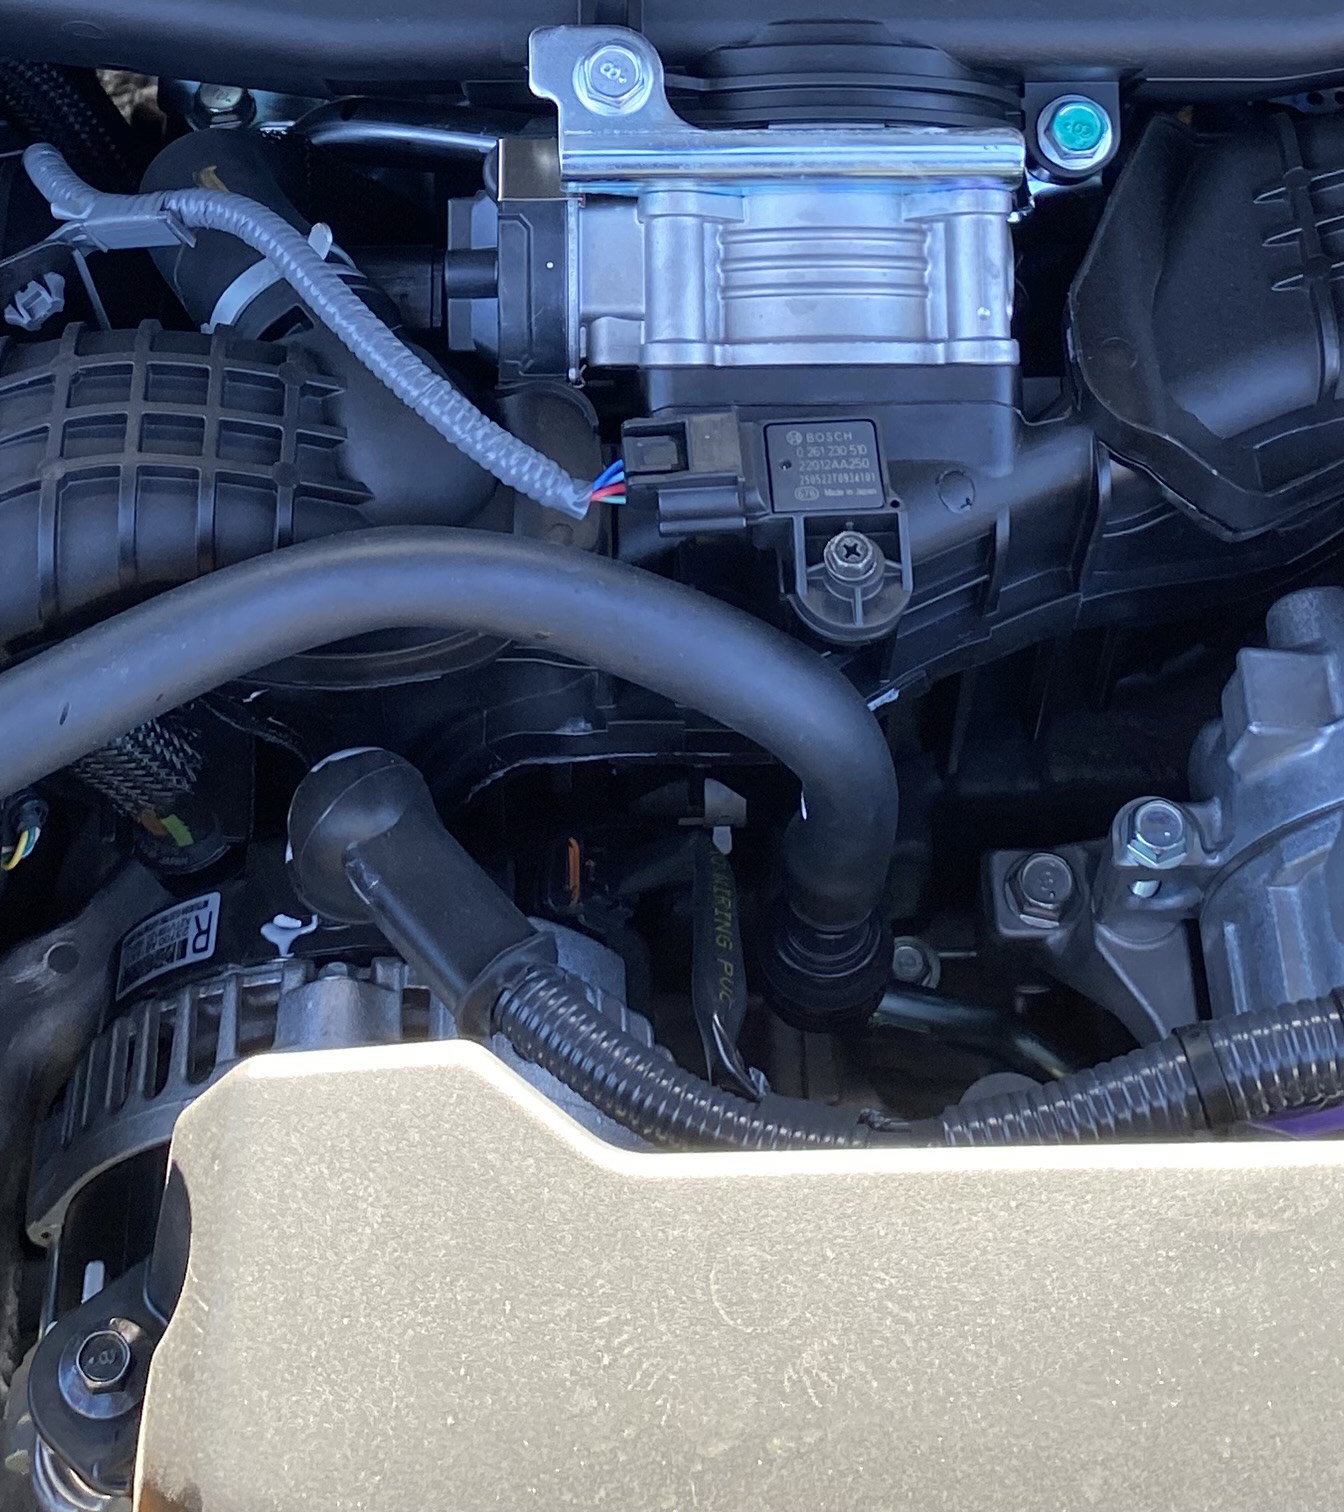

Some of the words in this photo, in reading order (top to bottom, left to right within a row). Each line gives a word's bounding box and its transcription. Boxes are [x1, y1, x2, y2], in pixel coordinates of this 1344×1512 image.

[805, 431, 853, 443] BOSCH
[807, 446, 825, 457] 261
[828, 445, 847, 457] 230
[849, 444, 867, 456] 510
[799, 458, 869, 471] 22012AA250
[192, 910, 212, 954] R
